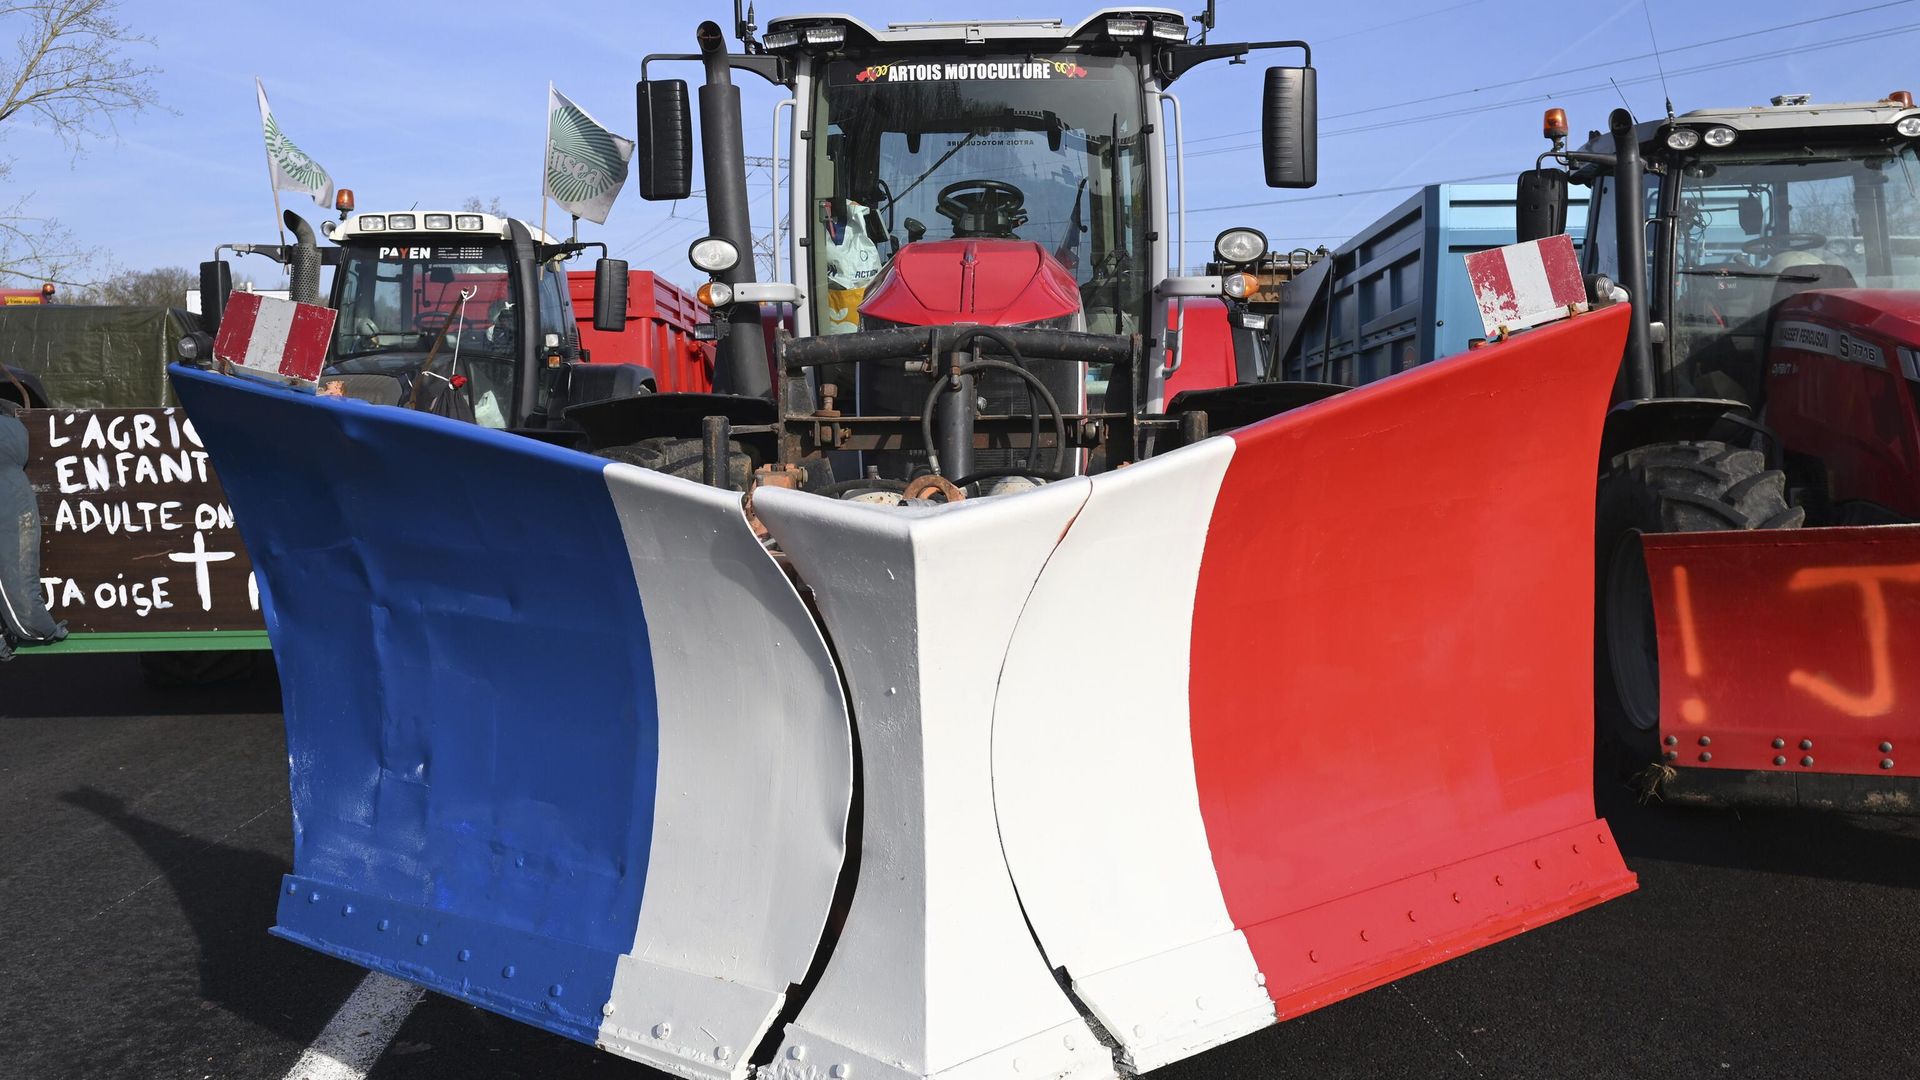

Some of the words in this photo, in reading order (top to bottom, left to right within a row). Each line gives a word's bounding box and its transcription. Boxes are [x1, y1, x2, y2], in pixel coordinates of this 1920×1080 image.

[888, 63, 942, 82] ARTOIS
[945, 62, 1051, 81] MOTOCULTURE
[379, 247, 431, 260] PAYEN
[1799, 329, 1830, 349] FERGUSON
[1840, 334, 1849, 357] S
[1852, 343, 1876, 361] 7716
[54, 450, 209, 494] ENFANT
[54, 499, 183, 535] ADULTE
